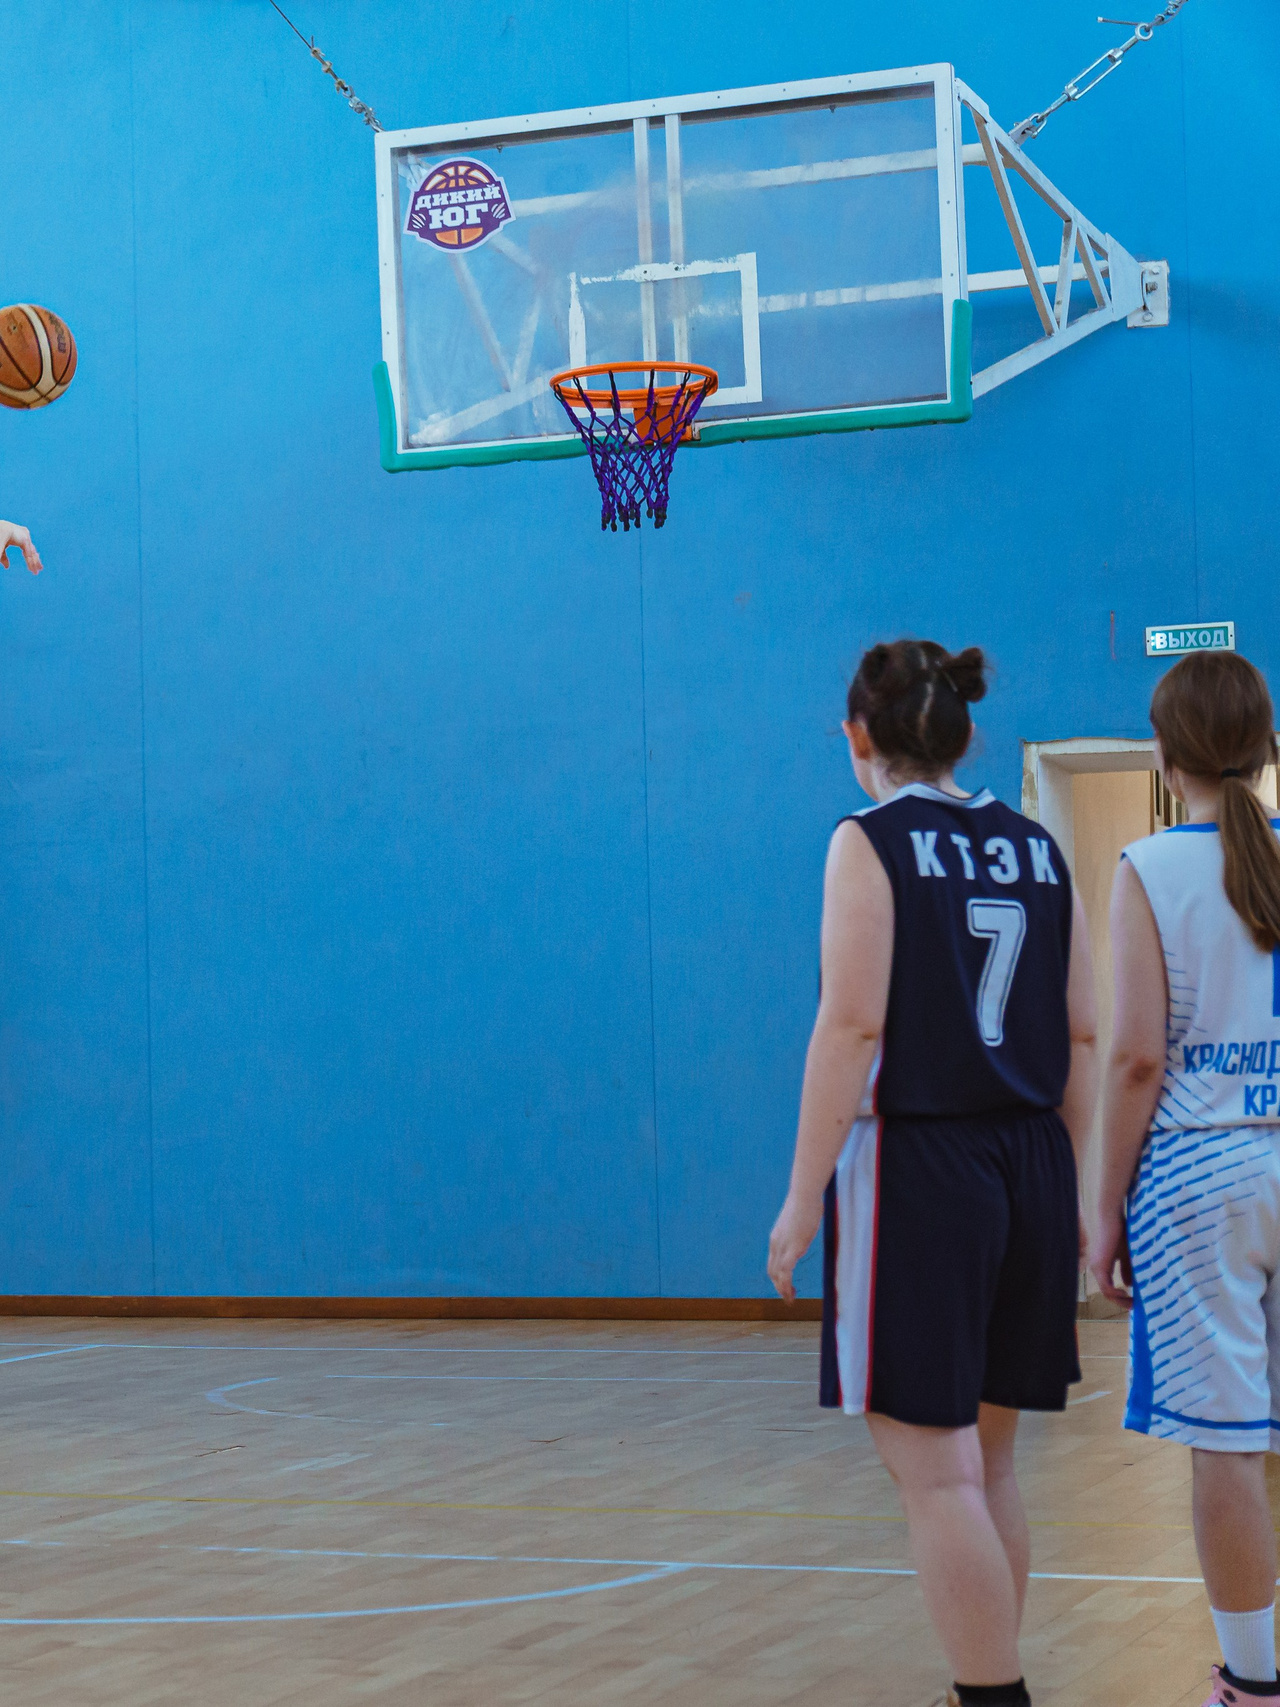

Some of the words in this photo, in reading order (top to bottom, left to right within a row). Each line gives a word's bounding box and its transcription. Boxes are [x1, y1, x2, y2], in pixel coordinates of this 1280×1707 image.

[415, 184, 502, 211] ДИКИЙ
[428, 202, 489, 230] ЮГ
[1155, 629, 1226, 650] ВЫХОД
[908, 830, 1059, 885] КТЭК
[966, 898, 1027, 1047] 7
[1244, 1084, 1280, 1117] КР
